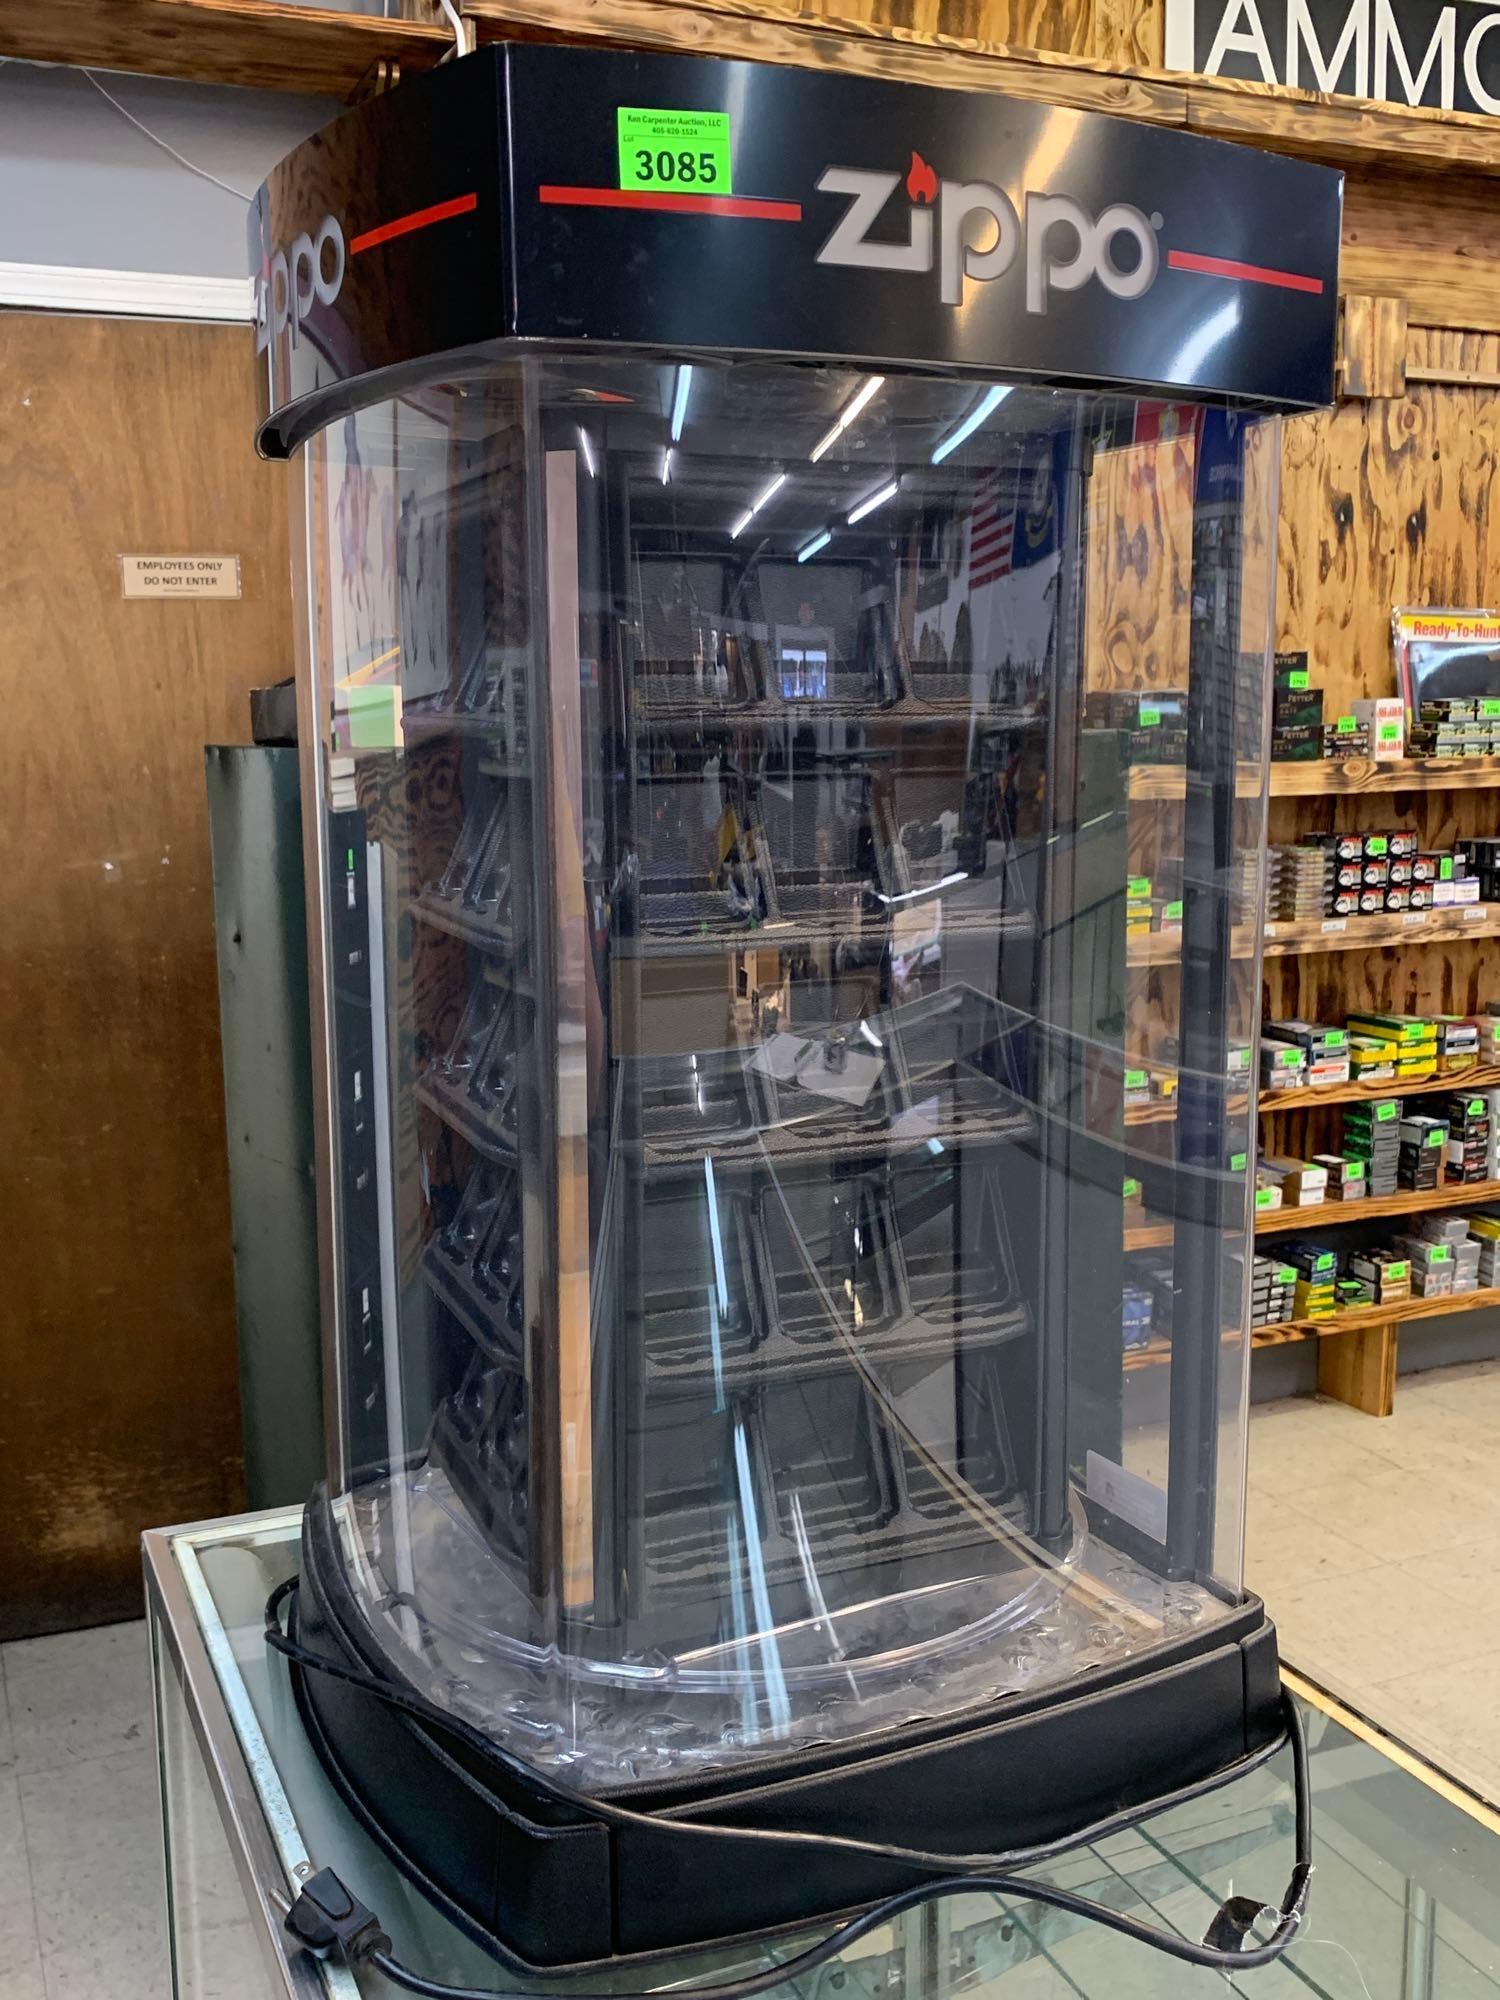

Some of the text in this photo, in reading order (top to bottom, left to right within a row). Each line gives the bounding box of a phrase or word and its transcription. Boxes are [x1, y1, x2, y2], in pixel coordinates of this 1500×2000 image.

[642, 116, 676, 126] Carpenter
[678, 119, 706, 127] Auction,
[708, 119, 721, 127] LLC
[635, 149, 717, 184] 3085
[137, 561, 223, 571] EMPLOYEES ONLY
[144, 576, 218, 586] DO NOT ENTER
